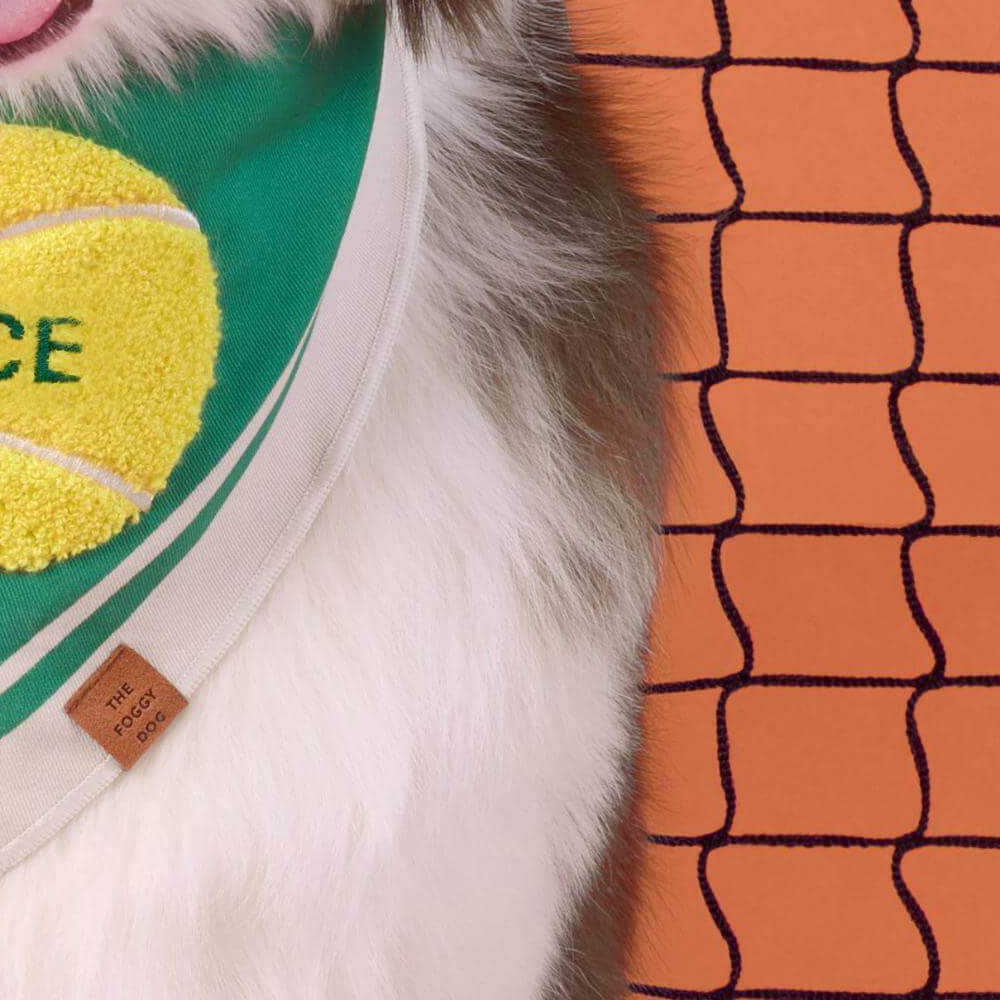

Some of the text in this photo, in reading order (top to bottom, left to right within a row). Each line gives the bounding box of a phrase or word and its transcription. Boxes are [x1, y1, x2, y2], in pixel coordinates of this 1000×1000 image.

[105, 682, 135, 710] THE
[113, 688, 157, 736] FOGGY
[136, 711, 166, 743] DOG
